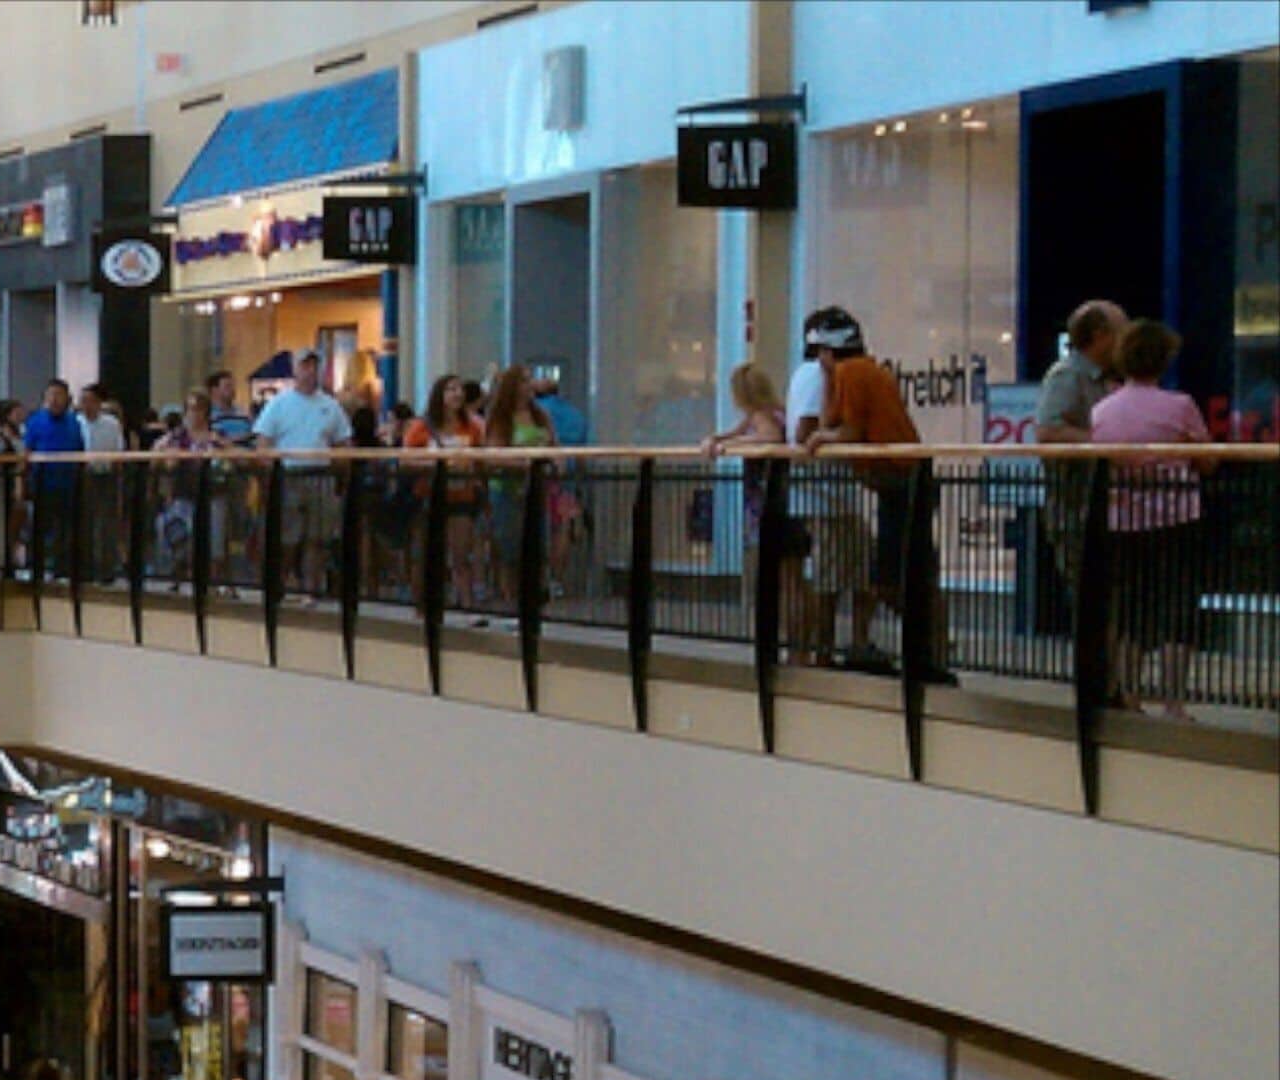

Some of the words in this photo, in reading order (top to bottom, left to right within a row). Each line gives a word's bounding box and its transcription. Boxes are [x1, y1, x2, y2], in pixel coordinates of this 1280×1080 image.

[706, 139, 770, 190] GAP
[348, 205, 394, 242] GAP
[883, 353, 967, 408] tretch
